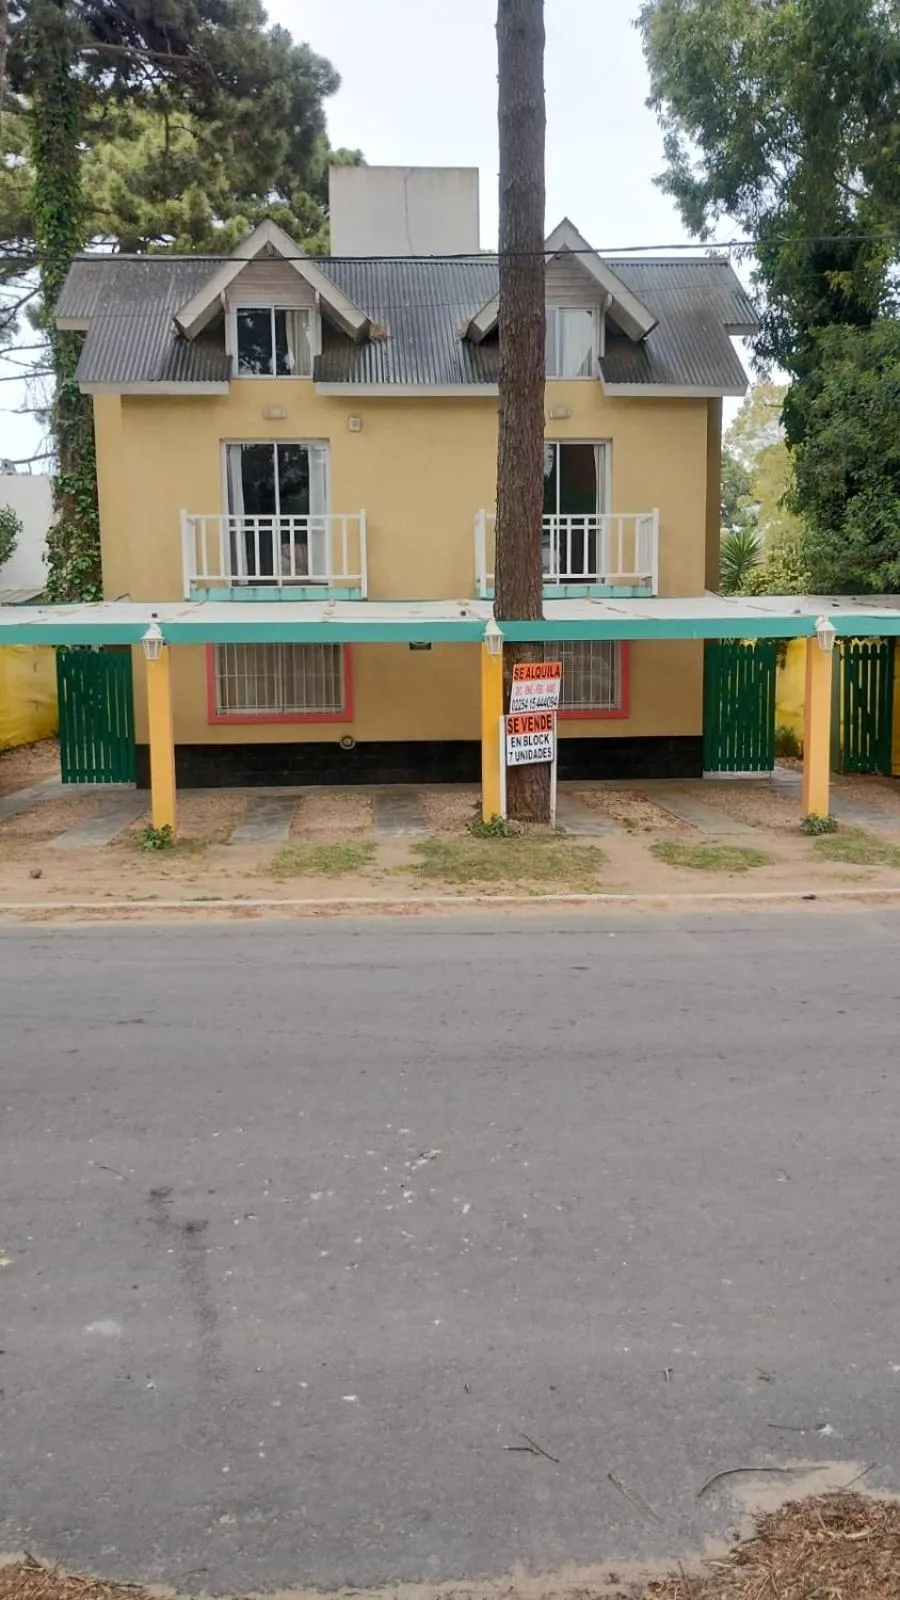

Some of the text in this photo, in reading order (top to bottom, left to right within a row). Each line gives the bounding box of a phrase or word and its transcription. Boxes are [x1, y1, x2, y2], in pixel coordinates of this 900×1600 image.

[513, 665, 561, 681] SE ALQUILA
[507, 714, 552, 734] SE VENDE
[511, 734, 549, 748] EN BLOCK
[508, 747, 552, 763] 7 UNIDADES
